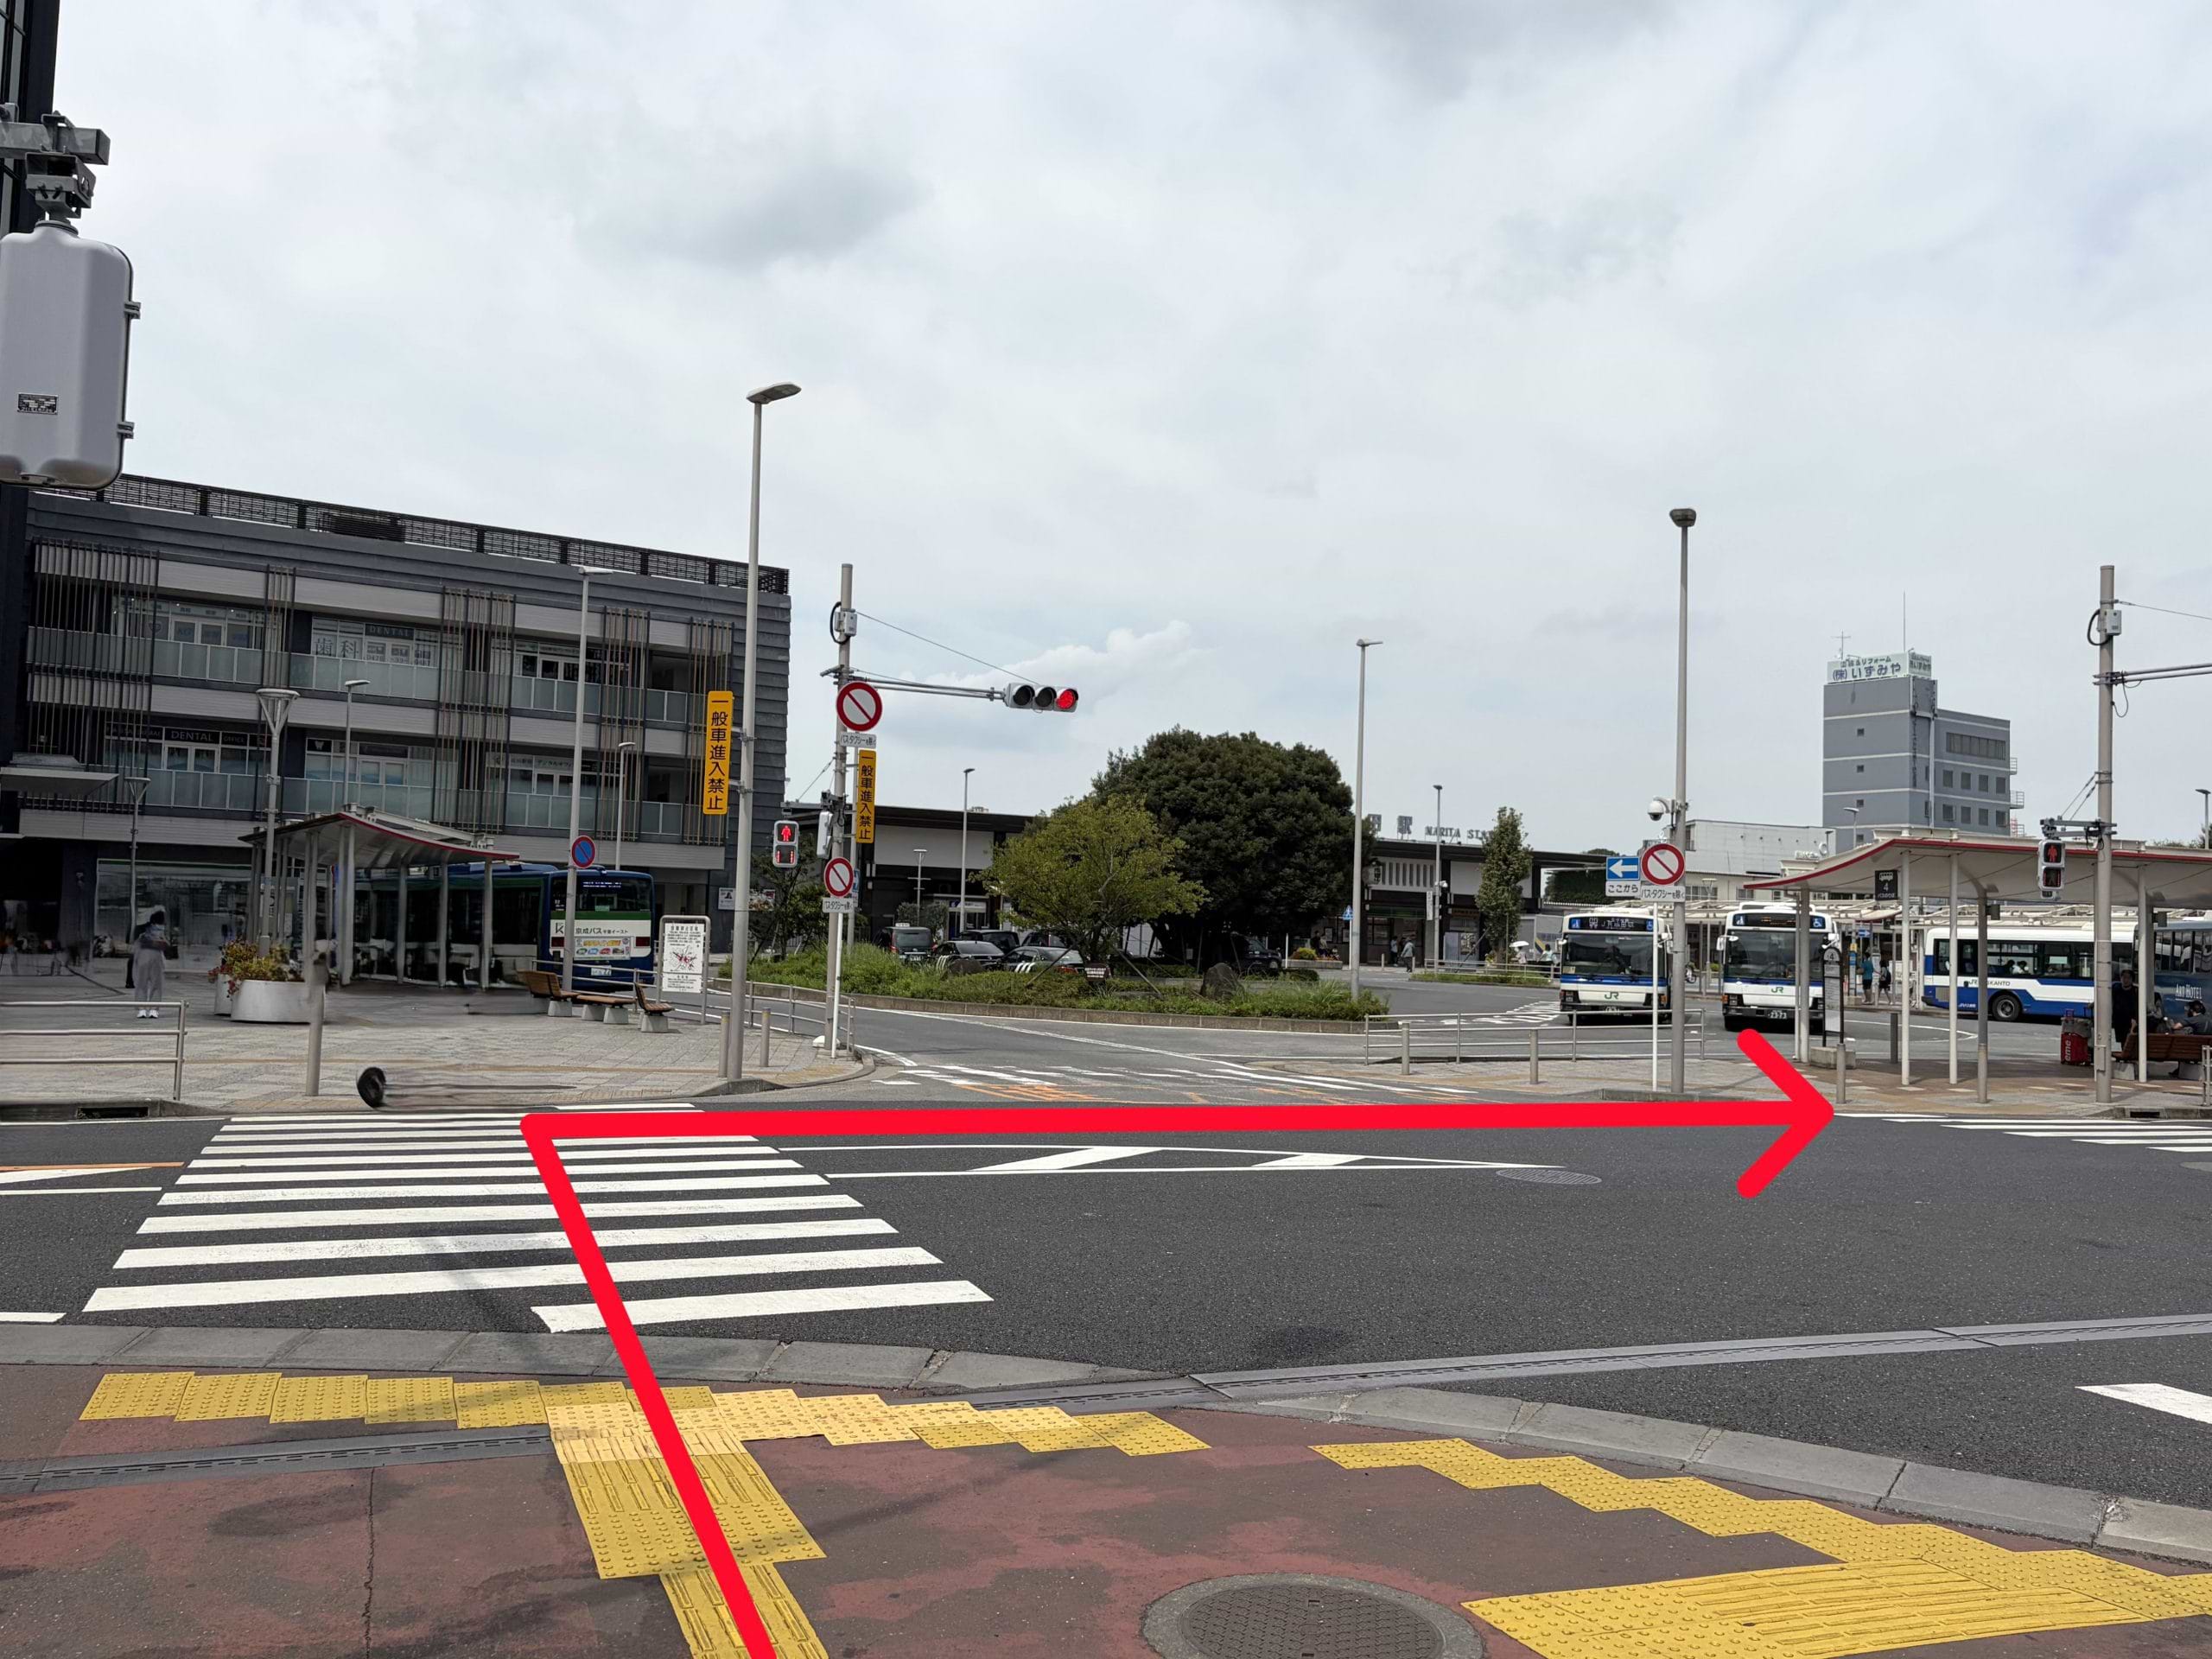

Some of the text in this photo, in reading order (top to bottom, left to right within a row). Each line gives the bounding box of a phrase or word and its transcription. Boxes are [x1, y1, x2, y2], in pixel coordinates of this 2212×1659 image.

[315, 637, 359, 658] 歯科
[170, 730, 213, 741] DENTAL
[707, 700, 728, 810] 一般車進入禁止
[858, 756, 874, 840] 一般車進入禁止
[1425, 826, 1461, 838] NARITA
[1608, 884, 1638, 893] ここから
[1883, 881, 1889, 892] 4
[1604, 991, 1619, 1000] JR
